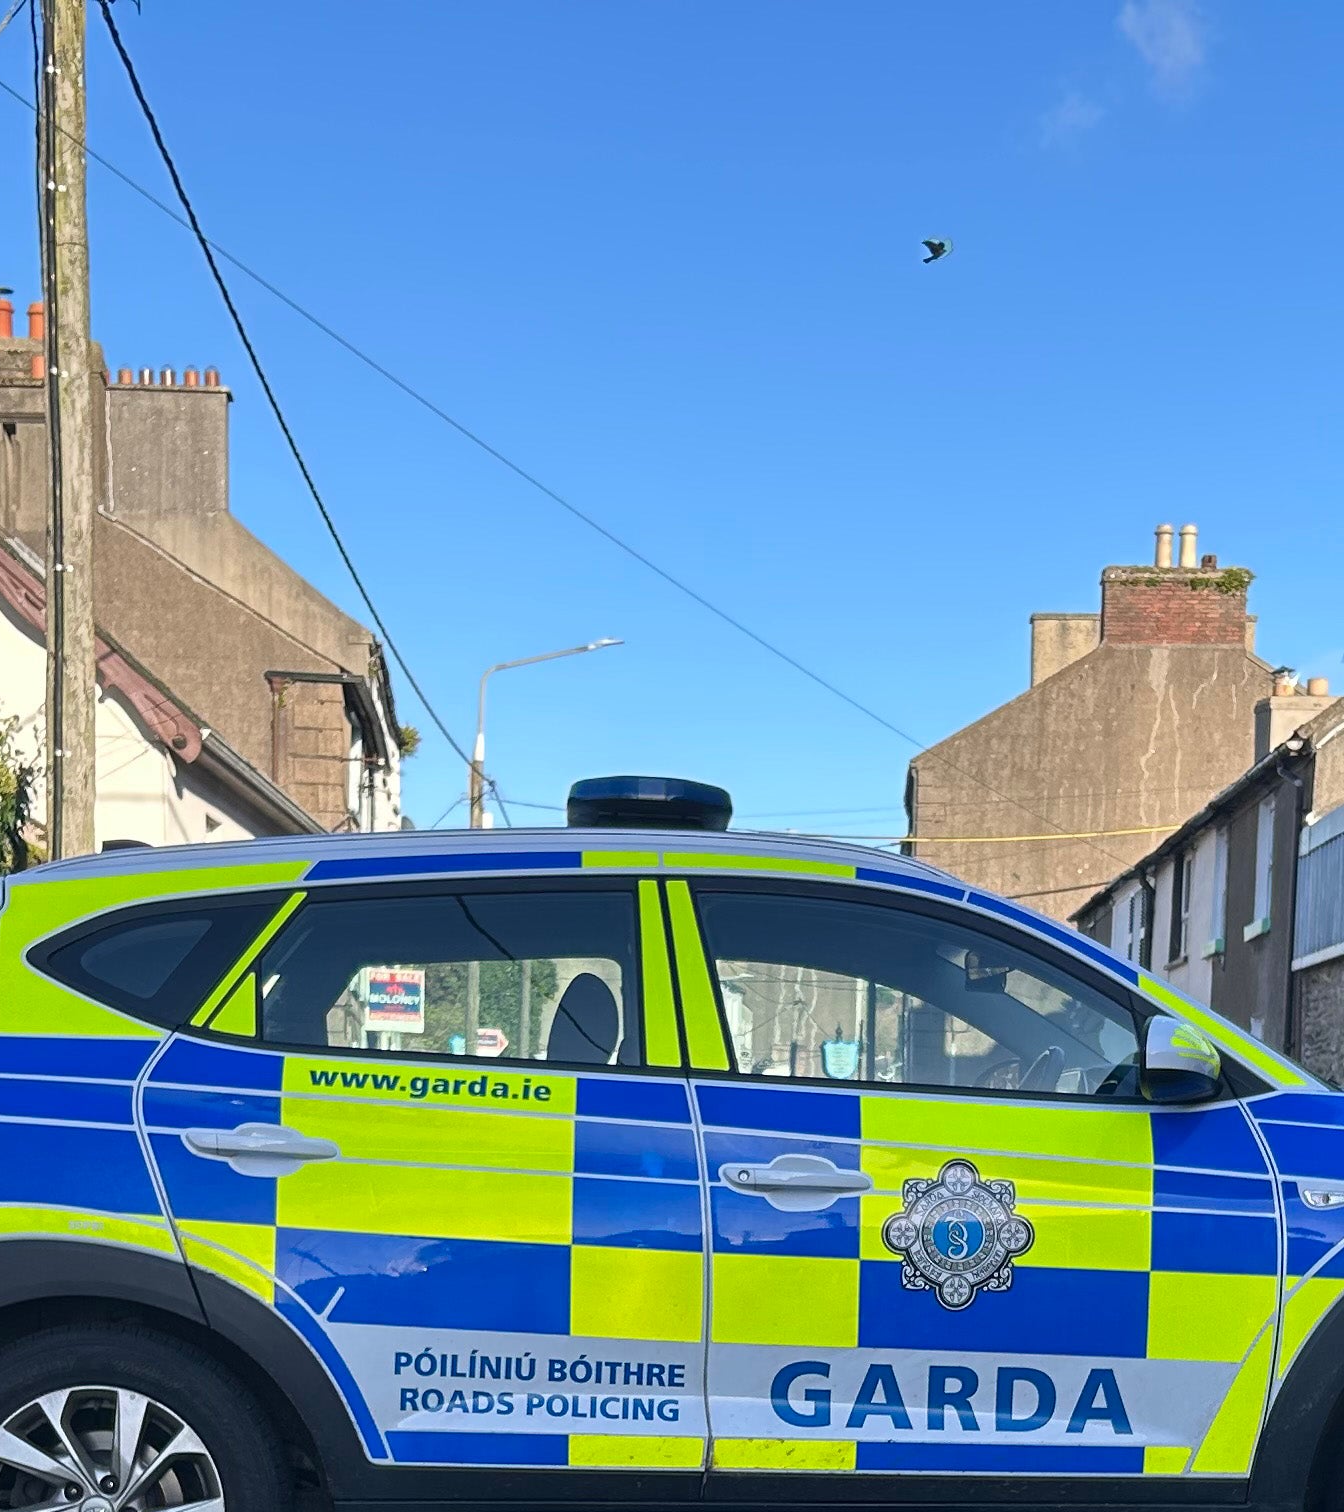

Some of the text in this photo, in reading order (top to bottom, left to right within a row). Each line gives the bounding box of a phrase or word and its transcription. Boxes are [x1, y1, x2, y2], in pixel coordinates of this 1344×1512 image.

[309, 1069, 552, 1101] www.garda.ie
[394, 1347, 686, 1388] PÓILÍNIÚ BÓITHRE
[399, 1388, 679, 1422] ROADS POLICING
[770, 1360, 1134, 1435] GARDA
